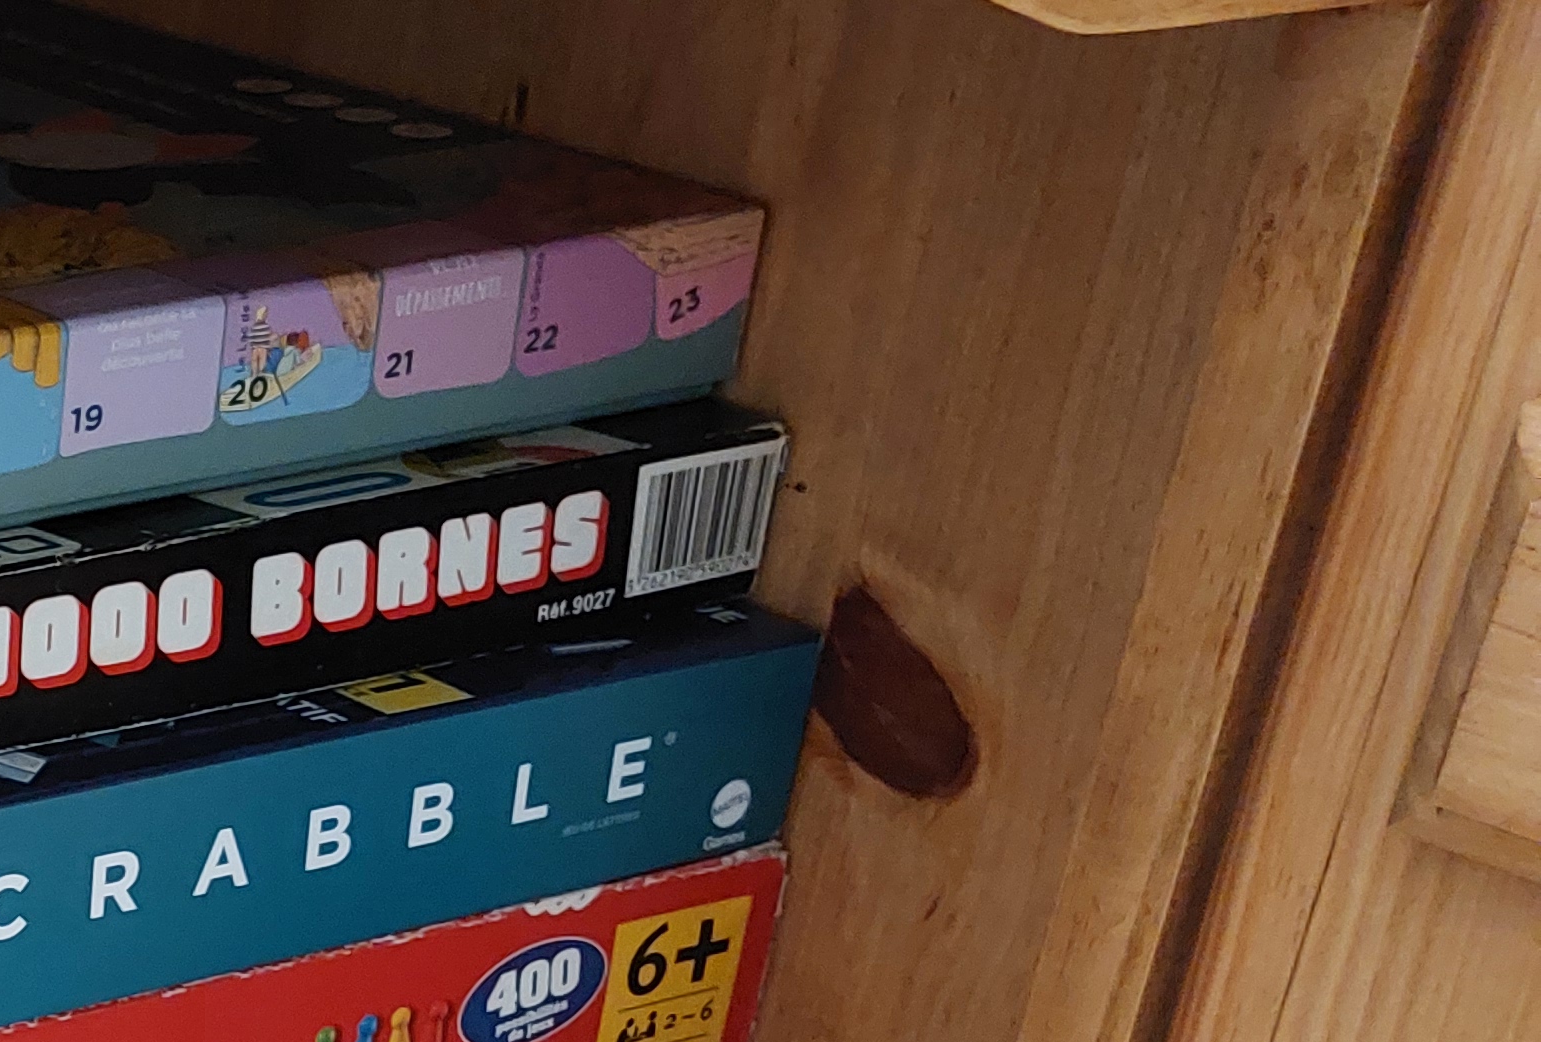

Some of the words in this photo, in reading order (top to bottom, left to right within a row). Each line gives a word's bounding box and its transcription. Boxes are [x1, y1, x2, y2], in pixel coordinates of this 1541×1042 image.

[668, 286, 702, 323] 23
[523, 324, 559, 355] 22
[383, 349, 416, 379] 21
[227, 374, 269, 408] 20
[68, 403, 104, 434] 19
[250, 490, 610, 647] BORNES
[626, 917, 731, 997] 6+
[486, 947, 582, 1018] 400
